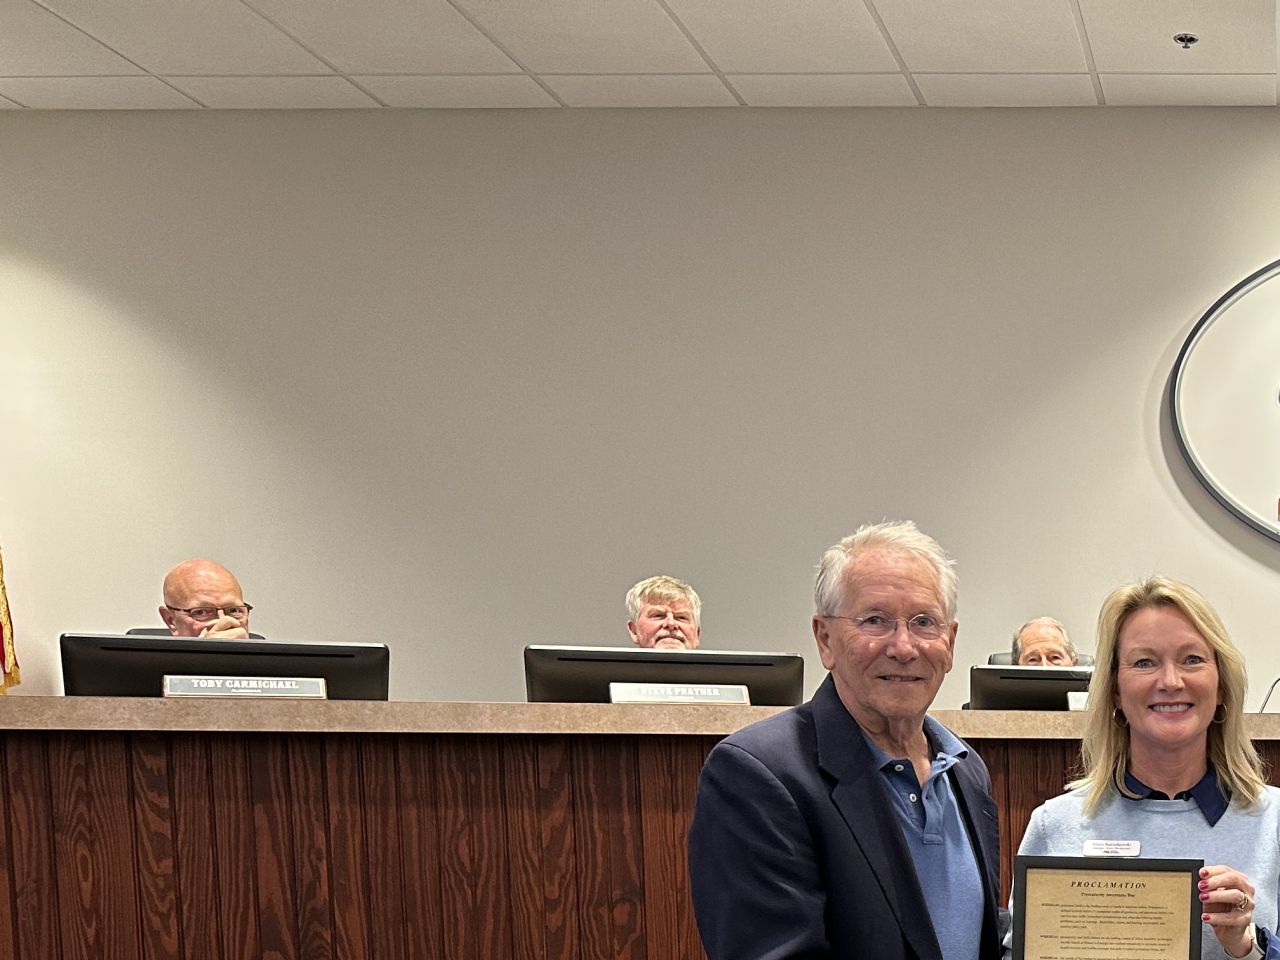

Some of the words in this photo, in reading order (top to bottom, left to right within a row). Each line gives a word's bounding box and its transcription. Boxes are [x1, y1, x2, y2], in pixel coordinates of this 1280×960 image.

[191, 679, 223, 688] TOBY
[225, 679, 299, 689] CARMICHAEL
[1071, 881, 1147, 889] PROCLAMATION
